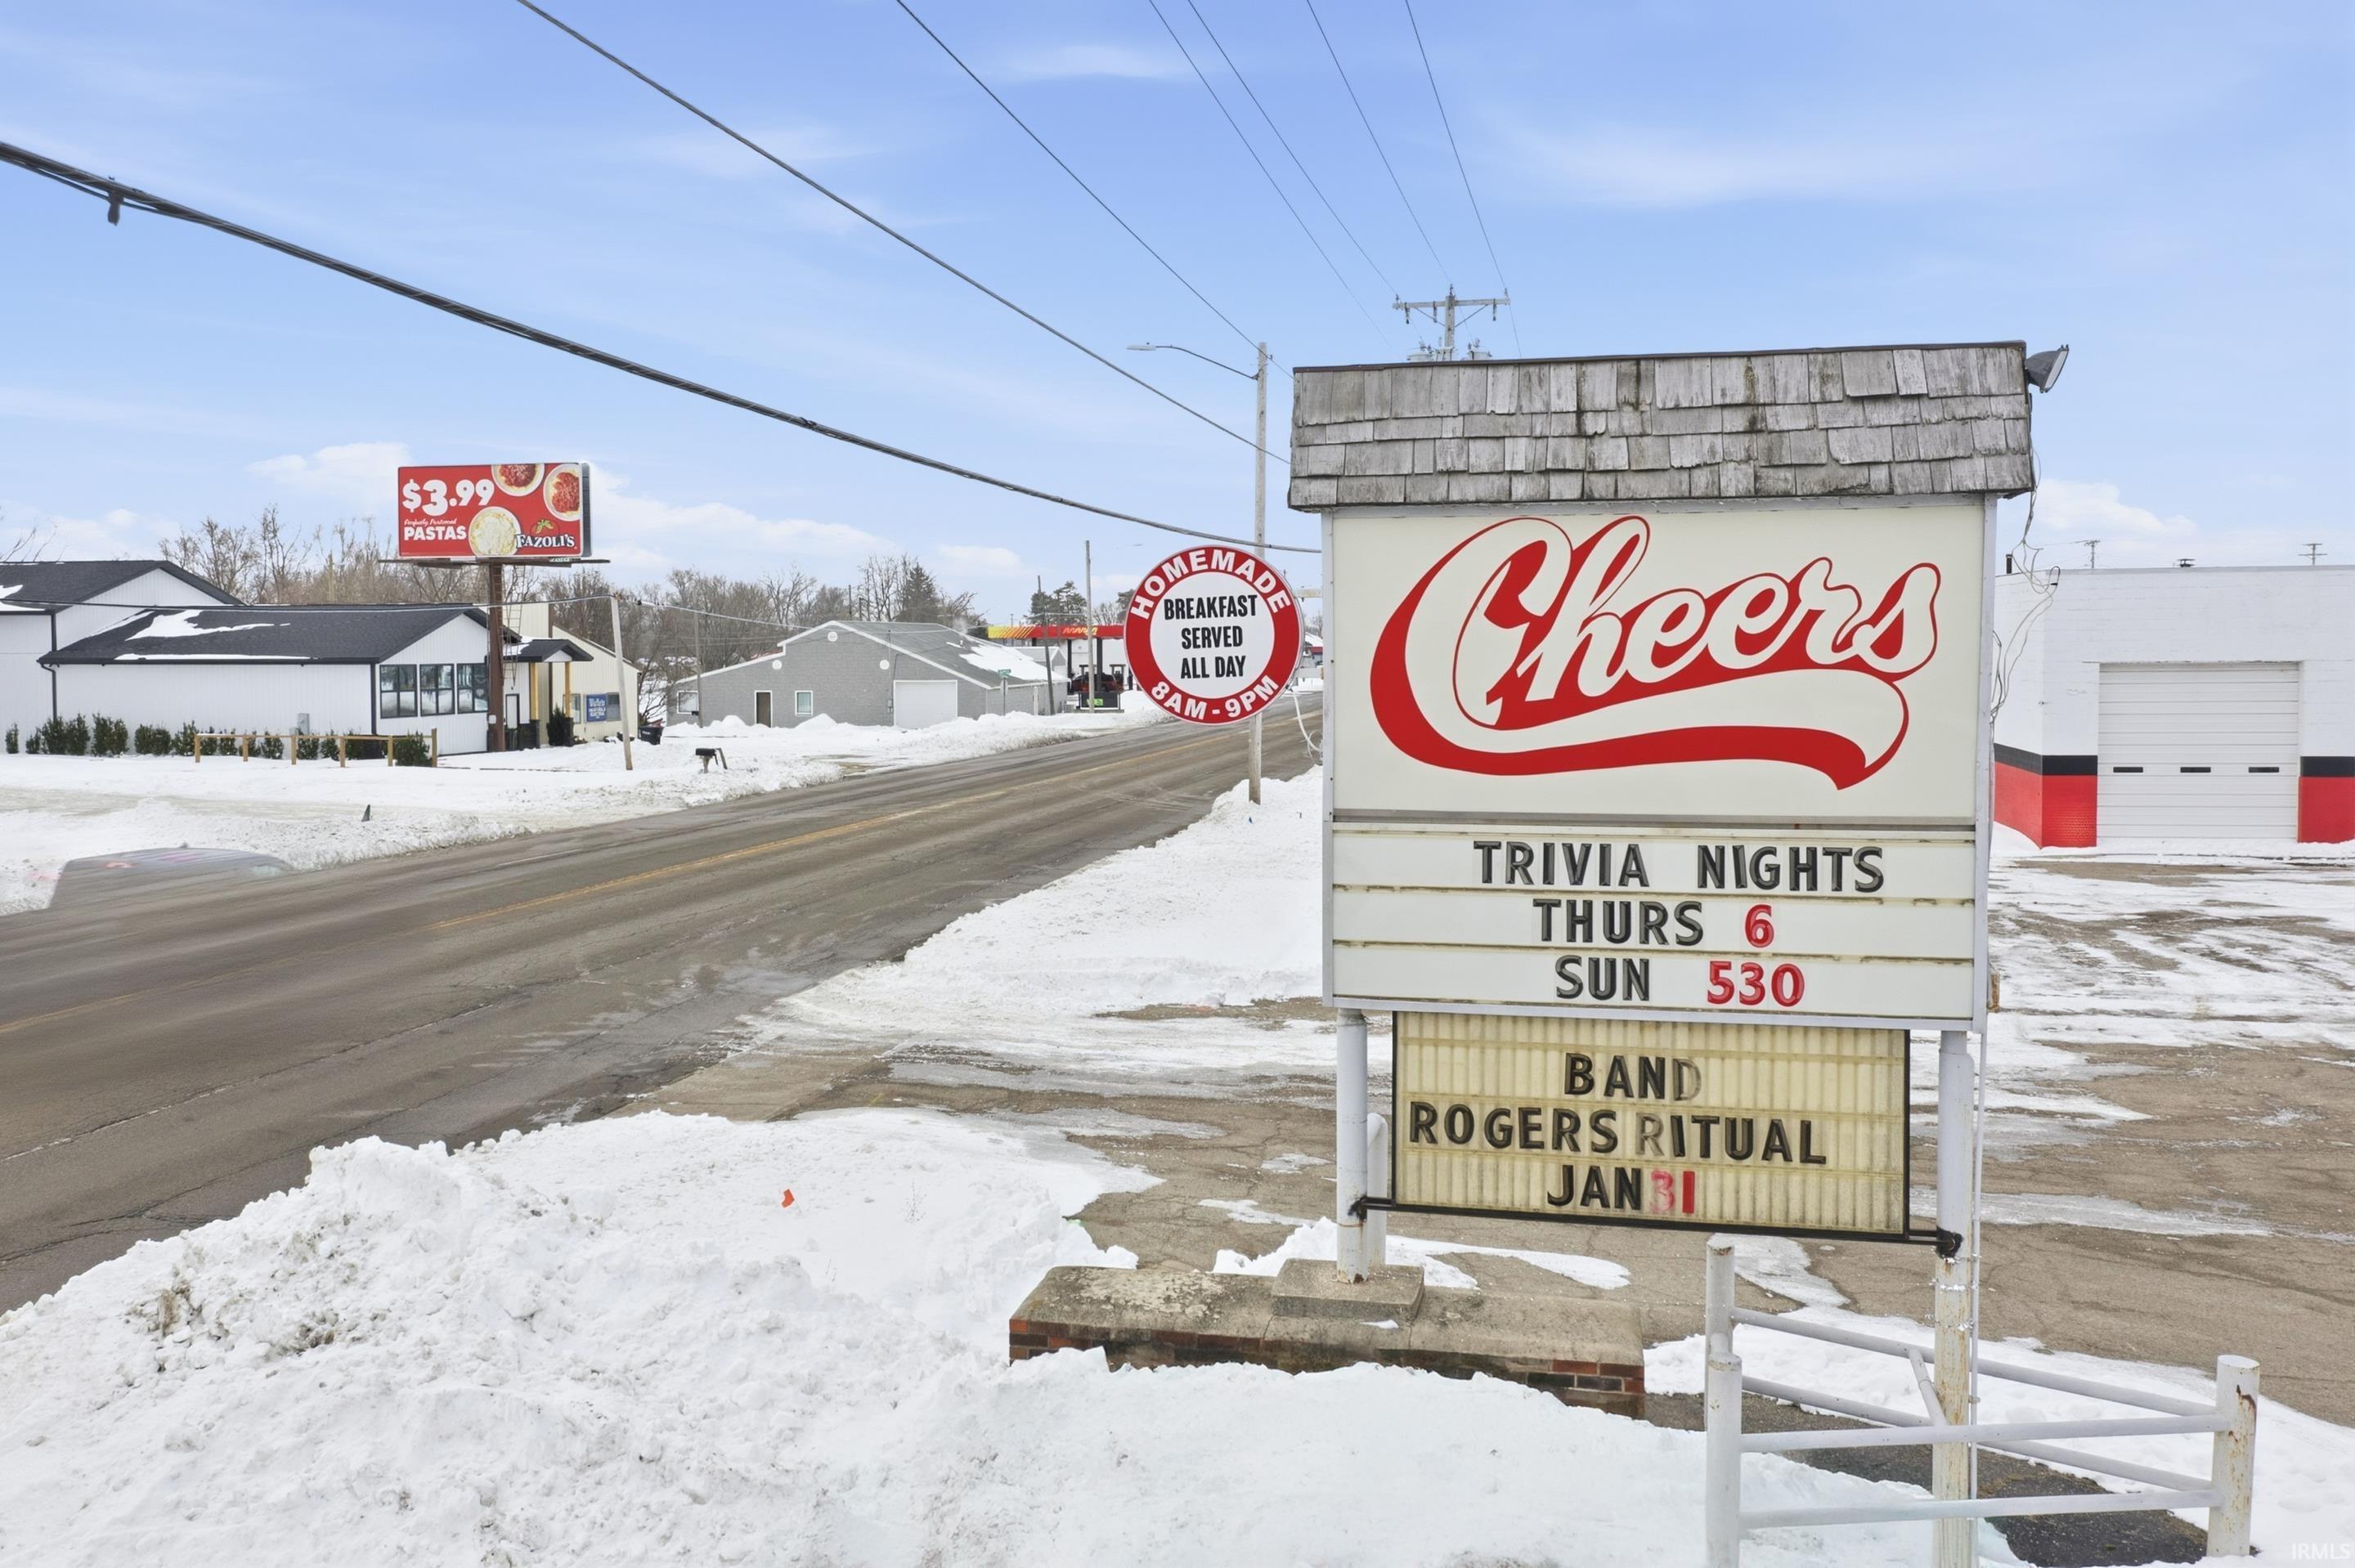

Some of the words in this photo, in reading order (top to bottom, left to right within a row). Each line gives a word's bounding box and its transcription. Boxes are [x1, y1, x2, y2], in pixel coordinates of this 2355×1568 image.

[402, 478, 495, 517] $3.99
[404, 526, 467, 541] PASTAS
[516, 534, 576, 549] FAZOLI'S
[1130, 549, 1290, 620] HOMEMADE
[1164, 594, 1258, 620] BREAKFAST
[1181, 625, 1243, 650] SERVED
[1370, 516, 1941, 790] Cheers
[1181, 657, 1209, 679] ALL
[1215, 656, 1246, 678] DAY
[1473, 840, 1650, 888] TRIVIA
[1697, 844, 1884, 892] NIGHTS
[1532, 898, 1703, 946] THURS
[1743, 904, 1774, 948] 6
[1554, 955, 1650, 1002] SUN
[1707, 960, 1805, 1007] 530
[1564, 1052, 1702, 1101] BAND
[1410, 1101, 1619, 1155] ROGERS
[1636, 1113, 1828, 1165] RITUAL
[1547, 1164, 1642, 1211] JAN
[1650, 1170, 1695, 1215] 31
